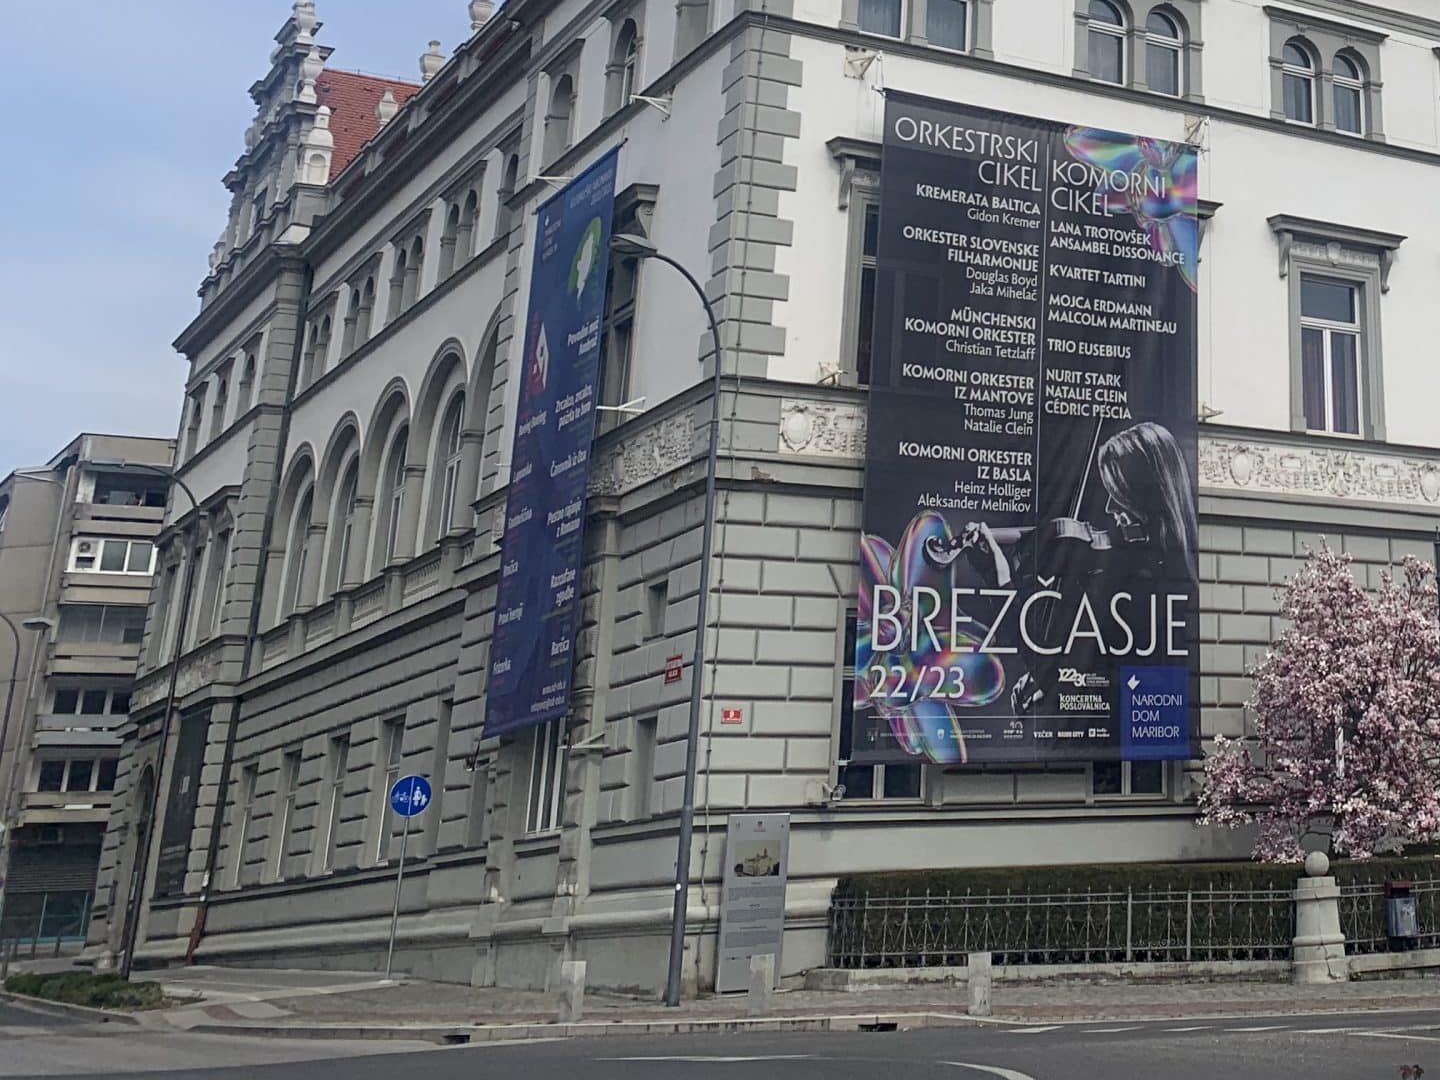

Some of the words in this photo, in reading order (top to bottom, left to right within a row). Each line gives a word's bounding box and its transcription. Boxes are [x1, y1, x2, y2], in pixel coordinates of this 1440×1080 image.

[895, 117, 1038, 163] ORKESTRSKI
[978, 161, 1042, 192] CIKEL
[1051, 159, 1166, 198] KOMORNI
[916, 184, 989, 208] KREMERATA
[992, 196, 1040, 215] BALTICA
[1051, 187, 1113, 218] CIKEL
[967, 208, 999, 224] Gidon
[1002, 213, 1040, 228] Kremer
[903, 226, 967, 247] ORKESTER
[969, 237, 1039, 257] SLOVENSKE
[1051, 221, 1082, 236] LANA
[1084, 224, 1151, 246] TROTOVŠEK
[948, 249, 1038, 272] FILHARMONIJE
[1050, 236, 1111, 257] ANSAMBEL
[1113, 246, 1184, 265] DISSONANCE
[966, 268, 1009, 286] Douglas
[1012, 272, 1038, 287] Boyd
[1049, 264, 1100, 282] KVARTET
[1102, 272, 1146, 288] TARTINI
[969, 282, 994, 298] Jaka
[996, 286, 1037, 301] Mihelač
[1049, 294, 1091, 311] MOJCA
[1093, 299, 1152, 317] ERDMANN
[951, 307, 1036, 330] MÜNCHENSKI
[1048, 310, 1108, 328] MALCOLM
[1110, 318, 1177, 334] MARTINEAU
[905, 318, 969, 339] KOMORNI
[972, 327, 1036, 346] ORKESTER
[945, 340, 992, 357] Christian
[995, 345, 1036, 360] Tetzlaff
[1048, 339, 1076, 353] TRIO
[1078, 343, 1131, 359] EUSEBIUS
[902, 363, 968, 383] KOMORNI
[970, 370, 1034, 390] ORKESTER
[1046, 369, 1083, 384] NURIT
[1085, 372, 1121, 387] STARK
[954, 386, 967, 399] IZ
[969, 388, 1034, 406] MANTOVE
[1045, 386, 1093, 401] NATALIE
[1095, 389, 1127, 403] CLEIN
[964, 403, 1005, 419] Thomas
[1007, 408, 1033, 423] Jung
[1045, 399, 1090, 416] CÉDRIC
[1092, 404, 1132, 420] PESCIA
[964, 419, 1002, 433] Natalie
[1005, 422, 1032, 436] Clein
[899, 442, 965, 462] KOMORNI
[967, 448, 1032, 466] ORKESTER
[977, 466, 990, 479] IZ
[993, 467, 1031, 482] BASLA
[955, 481, 984, 495] Heinz
[987, 483, 1031, 500] Holliger
[918, 494, 979, 511] Aleksander
[981, 498, 1031, 513] Melnikov
[871, 576, 1189, 657] BREZČASJE
[870, 664, 964, 701] 22/23
[1058, 693, 1102, 702] KONCERTNA
[1060, 702, 1110, 710] POSLOVALNICA
[1132, 695, 1182, 706] NARODNI
[1132, 710, 1159, 722] DOM
[1132, 726, 1179, 738] MARIBOR
